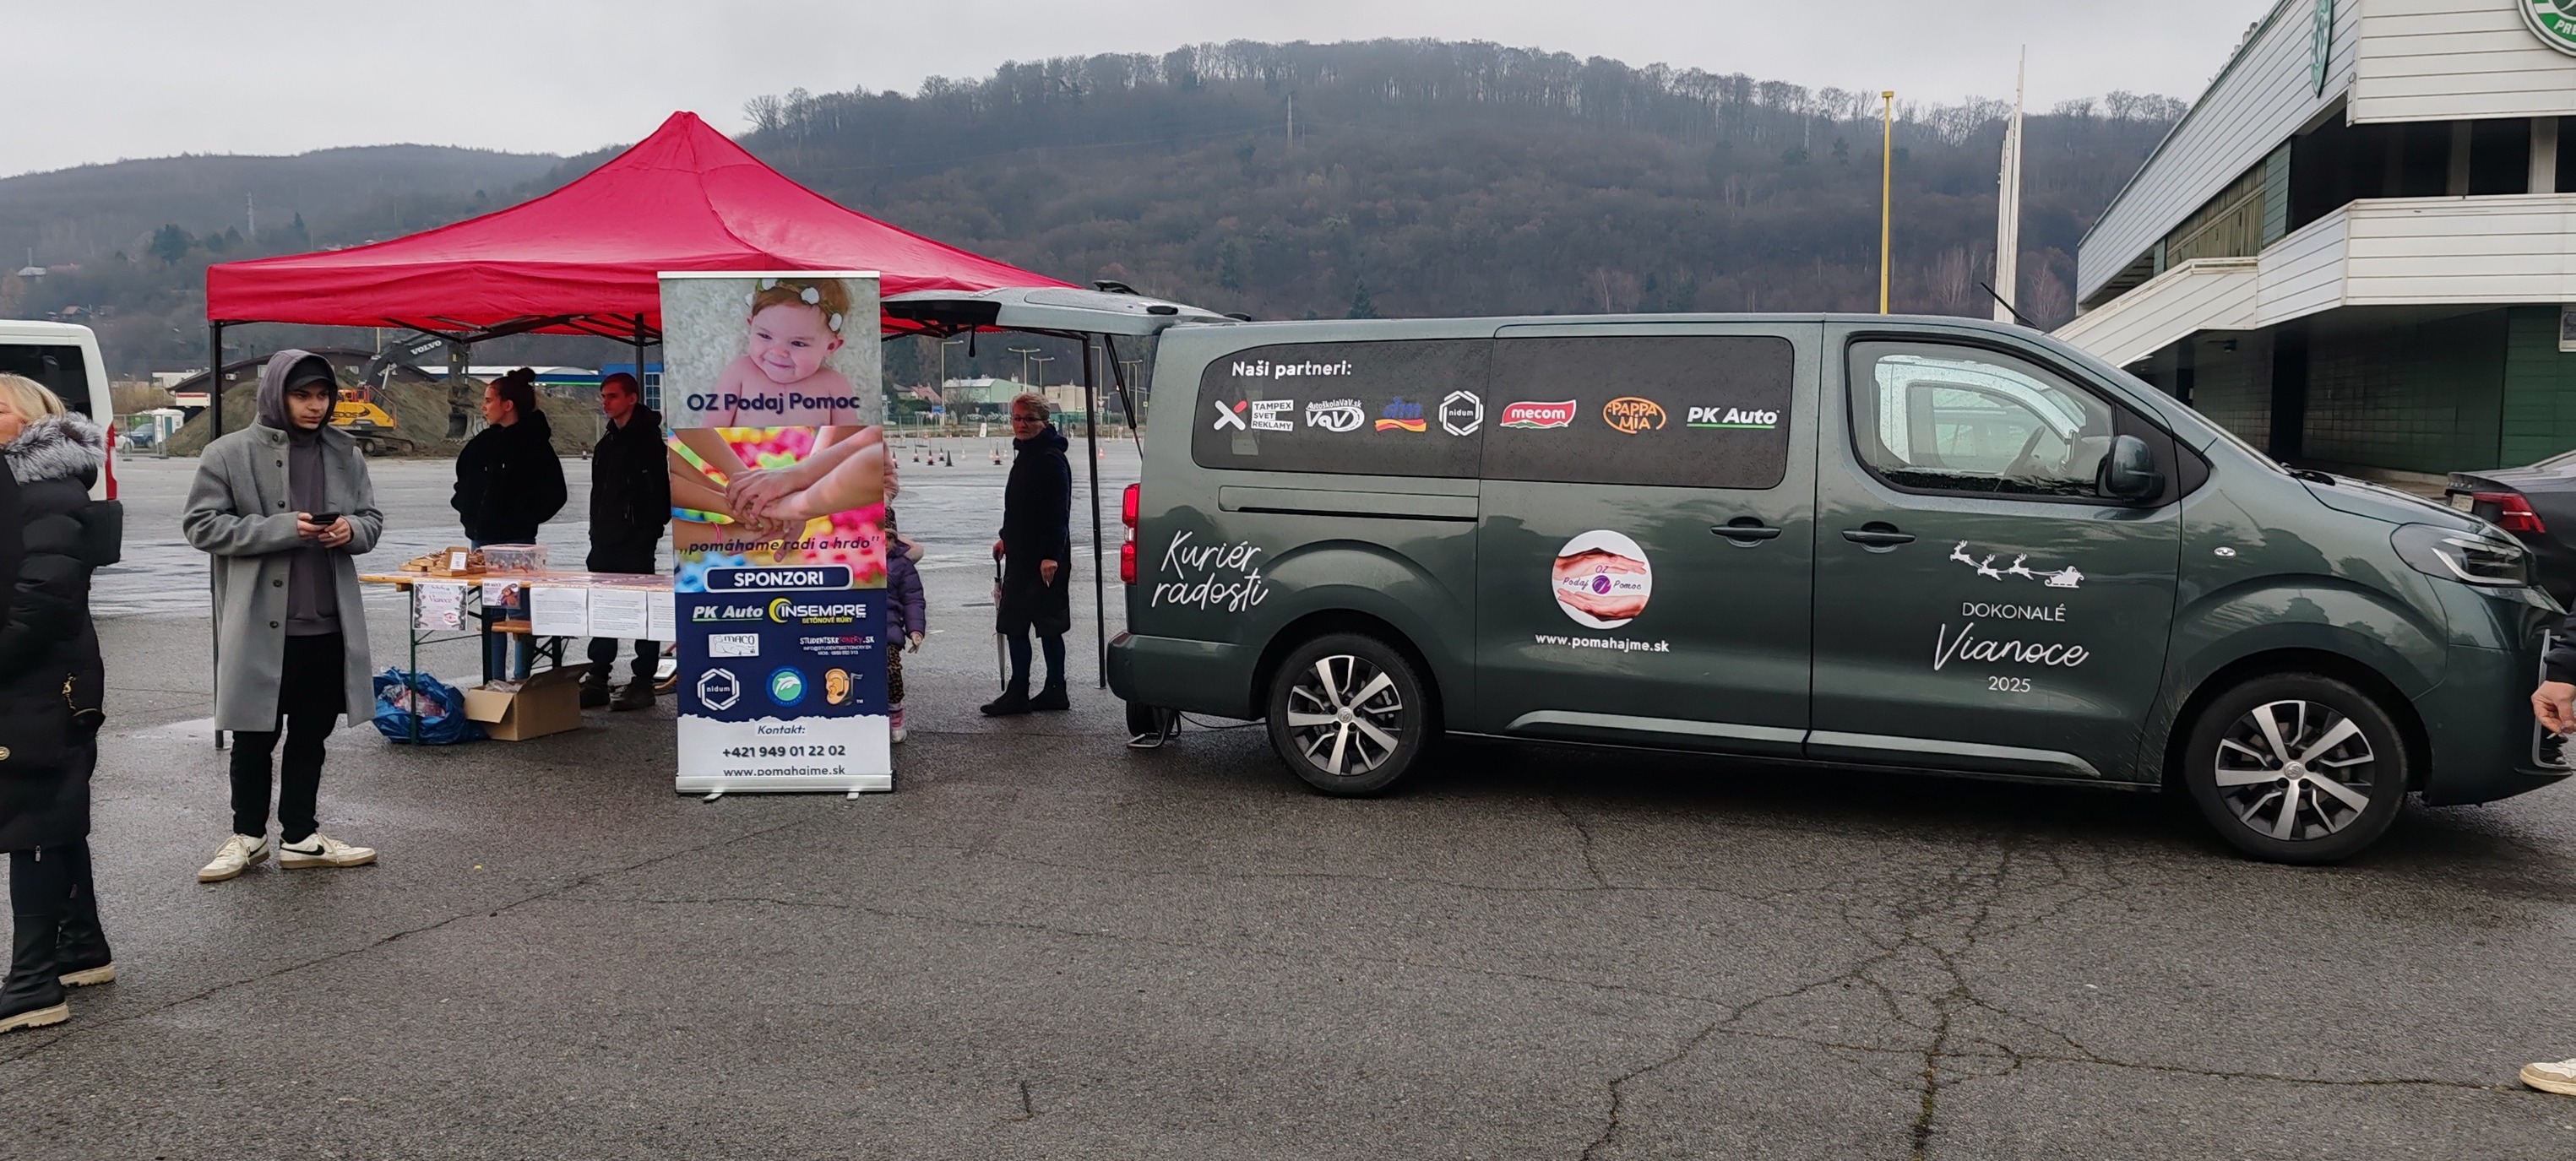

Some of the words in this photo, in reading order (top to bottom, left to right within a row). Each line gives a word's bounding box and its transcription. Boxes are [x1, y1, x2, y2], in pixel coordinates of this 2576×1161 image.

[410, 339, 442, 355] VOLVO
[1232, 360, 1269, 377] Naši
[1274, 361, 1351, 379] partneri:
[687, 393, 719, 411] OZ
[724, 393, 784, 414] Podaj
[789, 393, 860, 410] Pomoc
[1254, 402, 1291, 410] TAMPEX
[1307, 399, 1362, 409] AutoškolaVaV.sk
[1611, 403, 1658, 416] PAPPA
[1448, 409, 1474, 417] nidum
[1511, 408, 1566, 420] mecom
[1687, 407, 1720, 422] PK
[1722, 408, 1777, 424] Auto
[1253, 420, 1291, 430] REKLAMY
[784, 538, 816, 550] radi
[819, 540, 829, 550] a
[1160, 529, 1261, 579] Kuriér
[1595, 565, 1609, 573] OZ
[734, 571, 823, 587] SPONZORI
[1562, 578, 1589, 590] Podaj
[1613, 580, 1642, 589] Pomoc
[1151, 567, 1269, 612] radosti
[693, 605, 719, 619] PK
[721, 605, 764, 618] Auto
[781, 604, 867, 617] INSEMPRE
[1962, 602, 2067, 621] DOKONALÉ
[1535, 634, 1670, 653] www.pomahajme.sk
[1933, 621, 2090, 671] Vianoce
[1988, 676, 2031, 692] 2025
[758, 725, 806, 735] Kontakt:
[722, 746, 755, 757] +421
[759, 746, 785, 757] 949
[790, 746, 804, 757] 01
[808, 746, 826, 757] 22
[829, 746, 845, 757] 02
